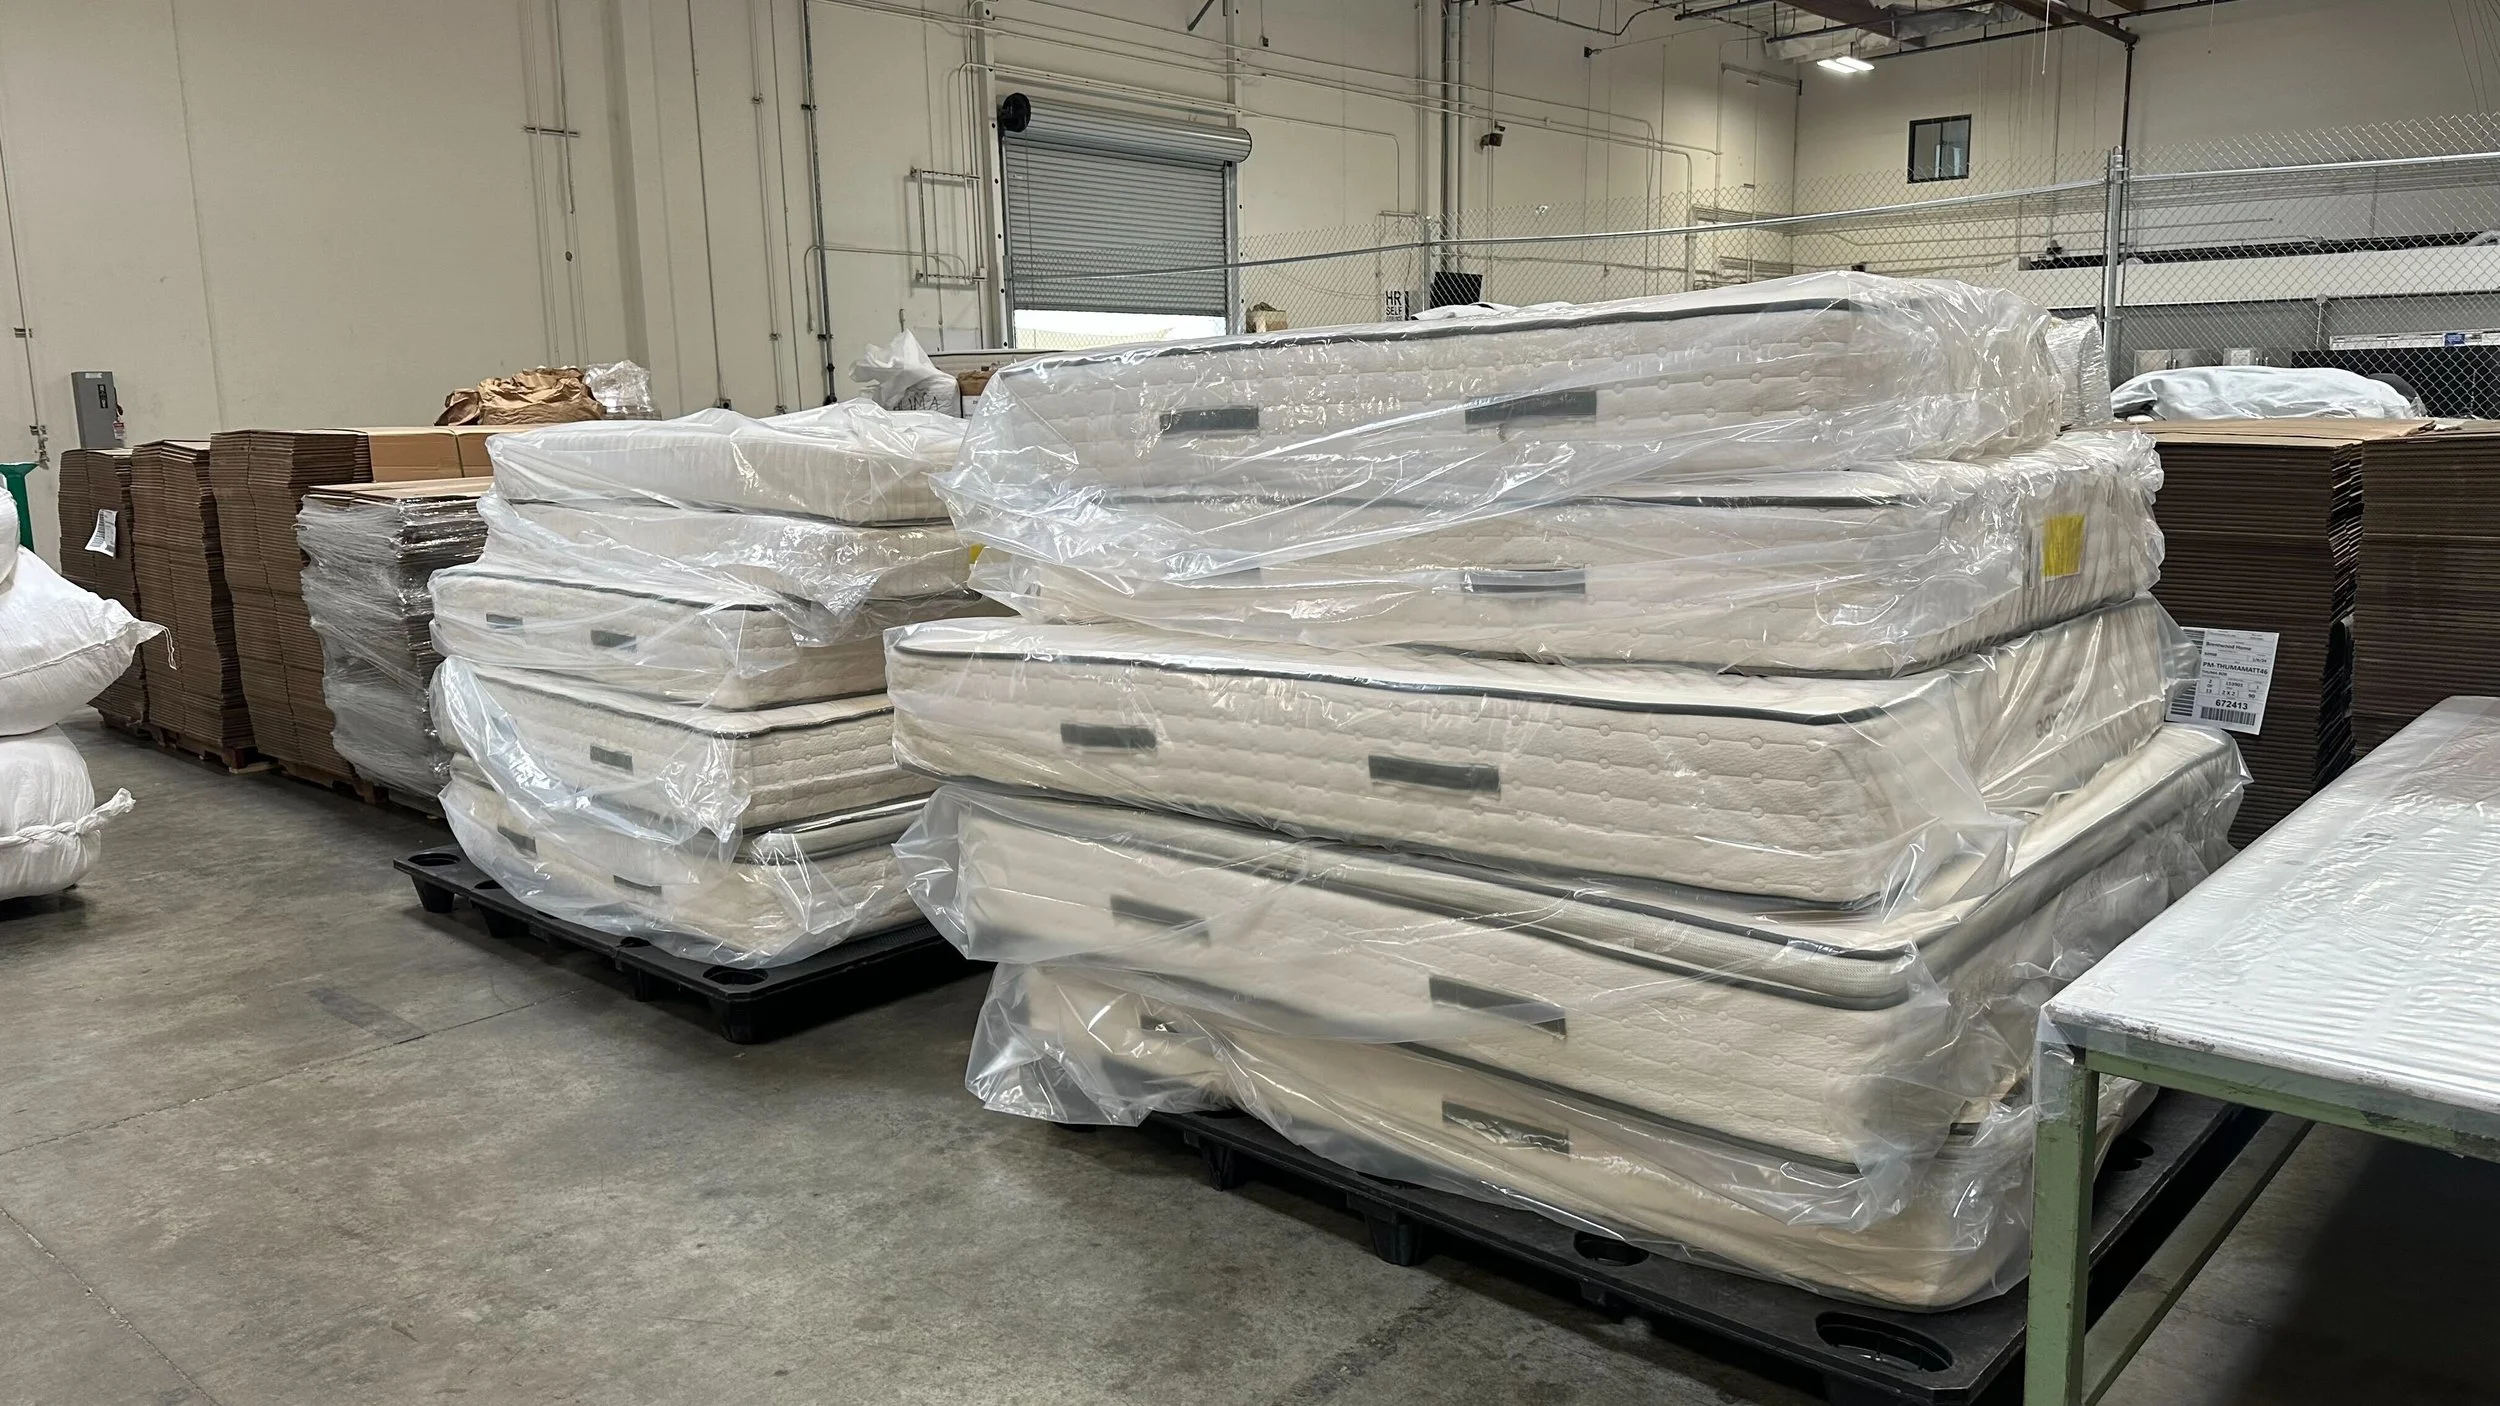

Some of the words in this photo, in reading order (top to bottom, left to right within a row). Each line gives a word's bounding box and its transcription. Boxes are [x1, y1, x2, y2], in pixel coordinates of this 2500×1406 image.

[1386, 291, 1401, 305] HR
[1386, 306, 1402, 315] SELF
[2206, 641, 2235, 650] Brentwood
[2215, 699, 2248, 710] 672413
